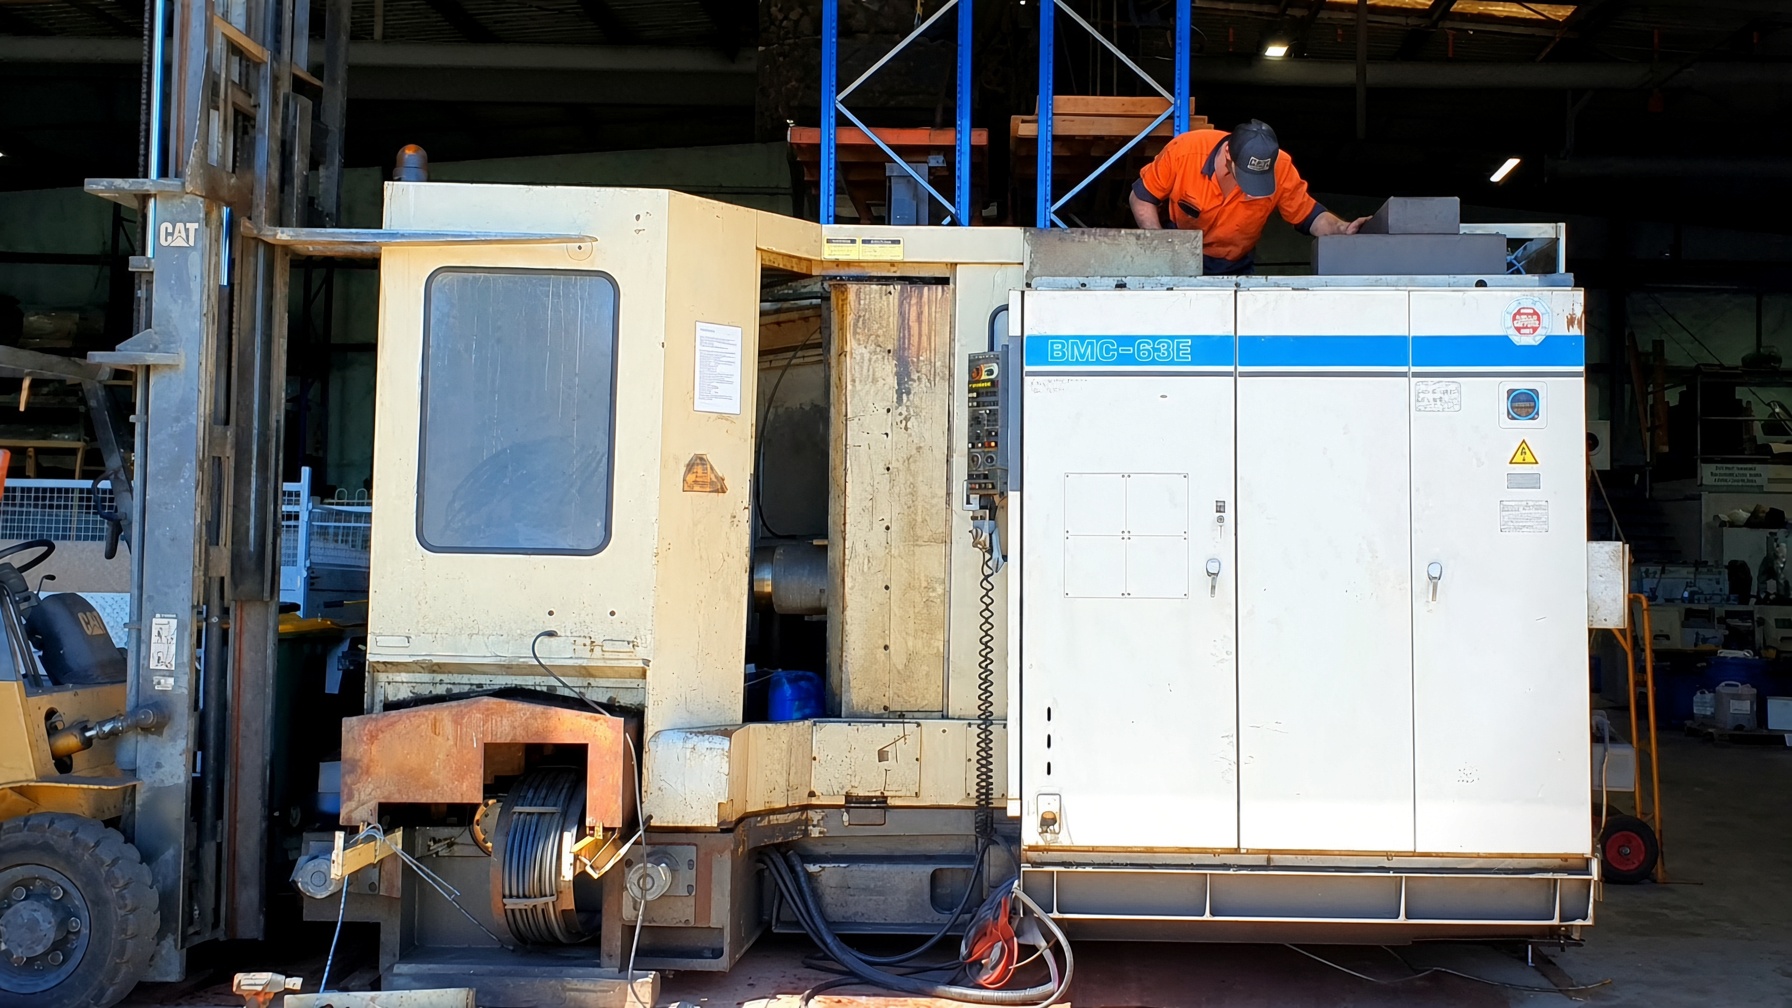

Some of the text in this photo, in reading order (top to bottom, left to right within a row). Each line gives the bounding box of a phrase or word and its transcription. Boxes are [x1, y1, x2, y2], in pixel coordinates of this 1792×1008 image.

[160, 222, 199, 246] CAT
[1048, 339, 1192, 362] BMC-63E
[77, 611, 106, 636] CAT
